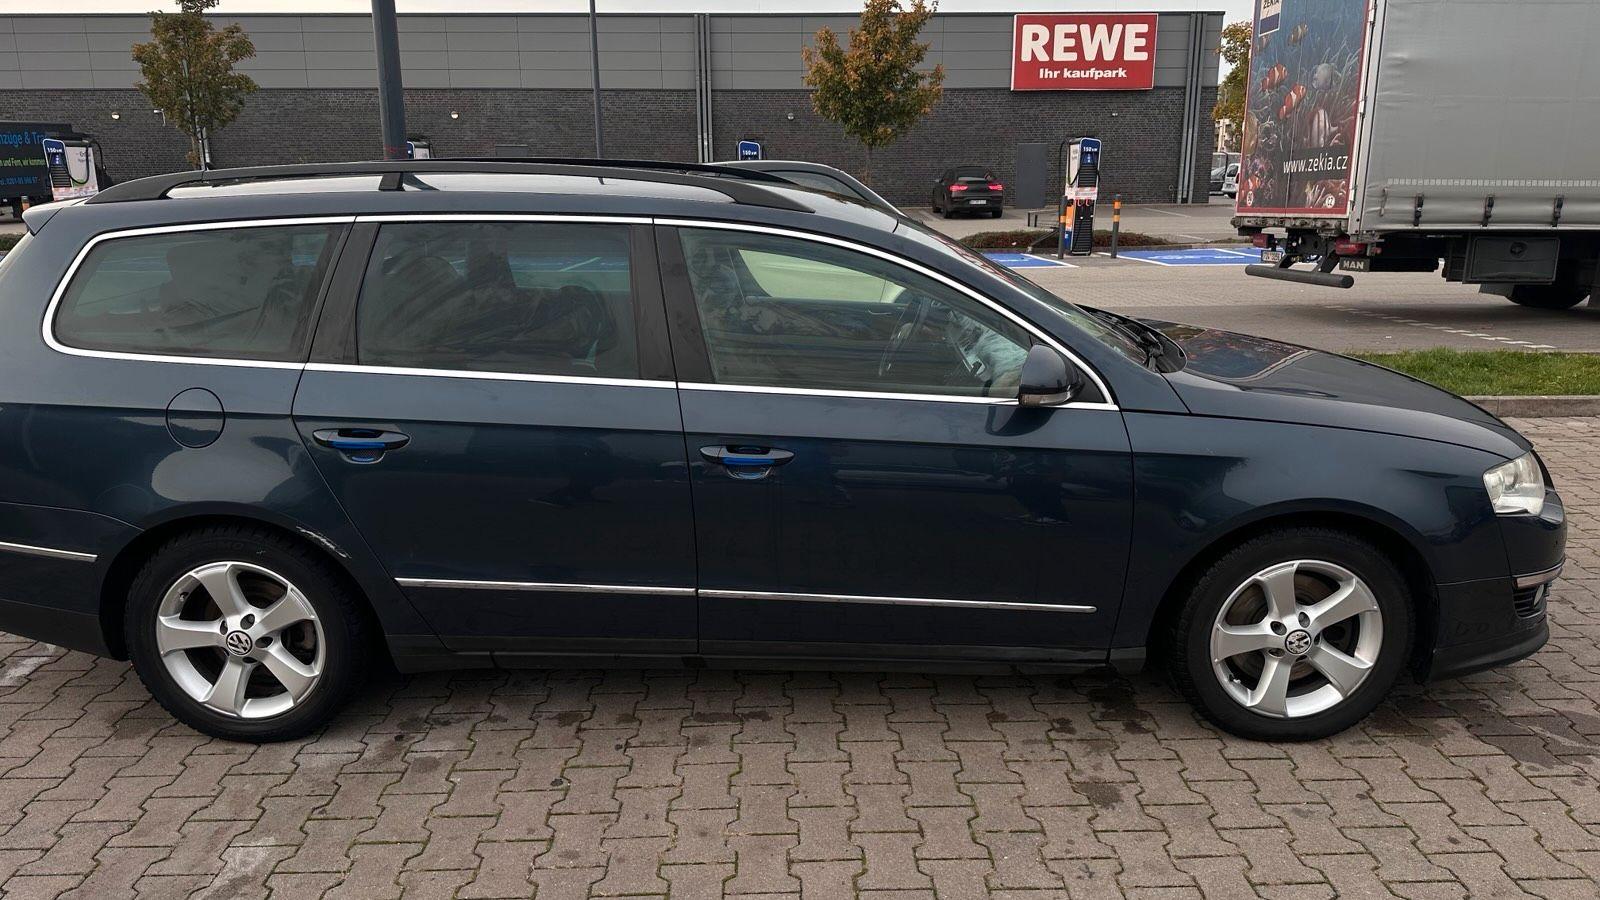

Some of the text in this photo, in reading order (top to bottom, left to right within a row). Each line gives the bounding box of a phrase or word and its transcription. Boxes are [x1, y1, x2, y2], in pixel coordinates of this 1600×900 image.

[1021, 24, 1149, 62] REWE
[1039, 67, 1127, 80] Ihr kaufpark
[1283, 152, 1348, 173] www.zekia.cz
[1343, 260, 1364, 270] MAN
